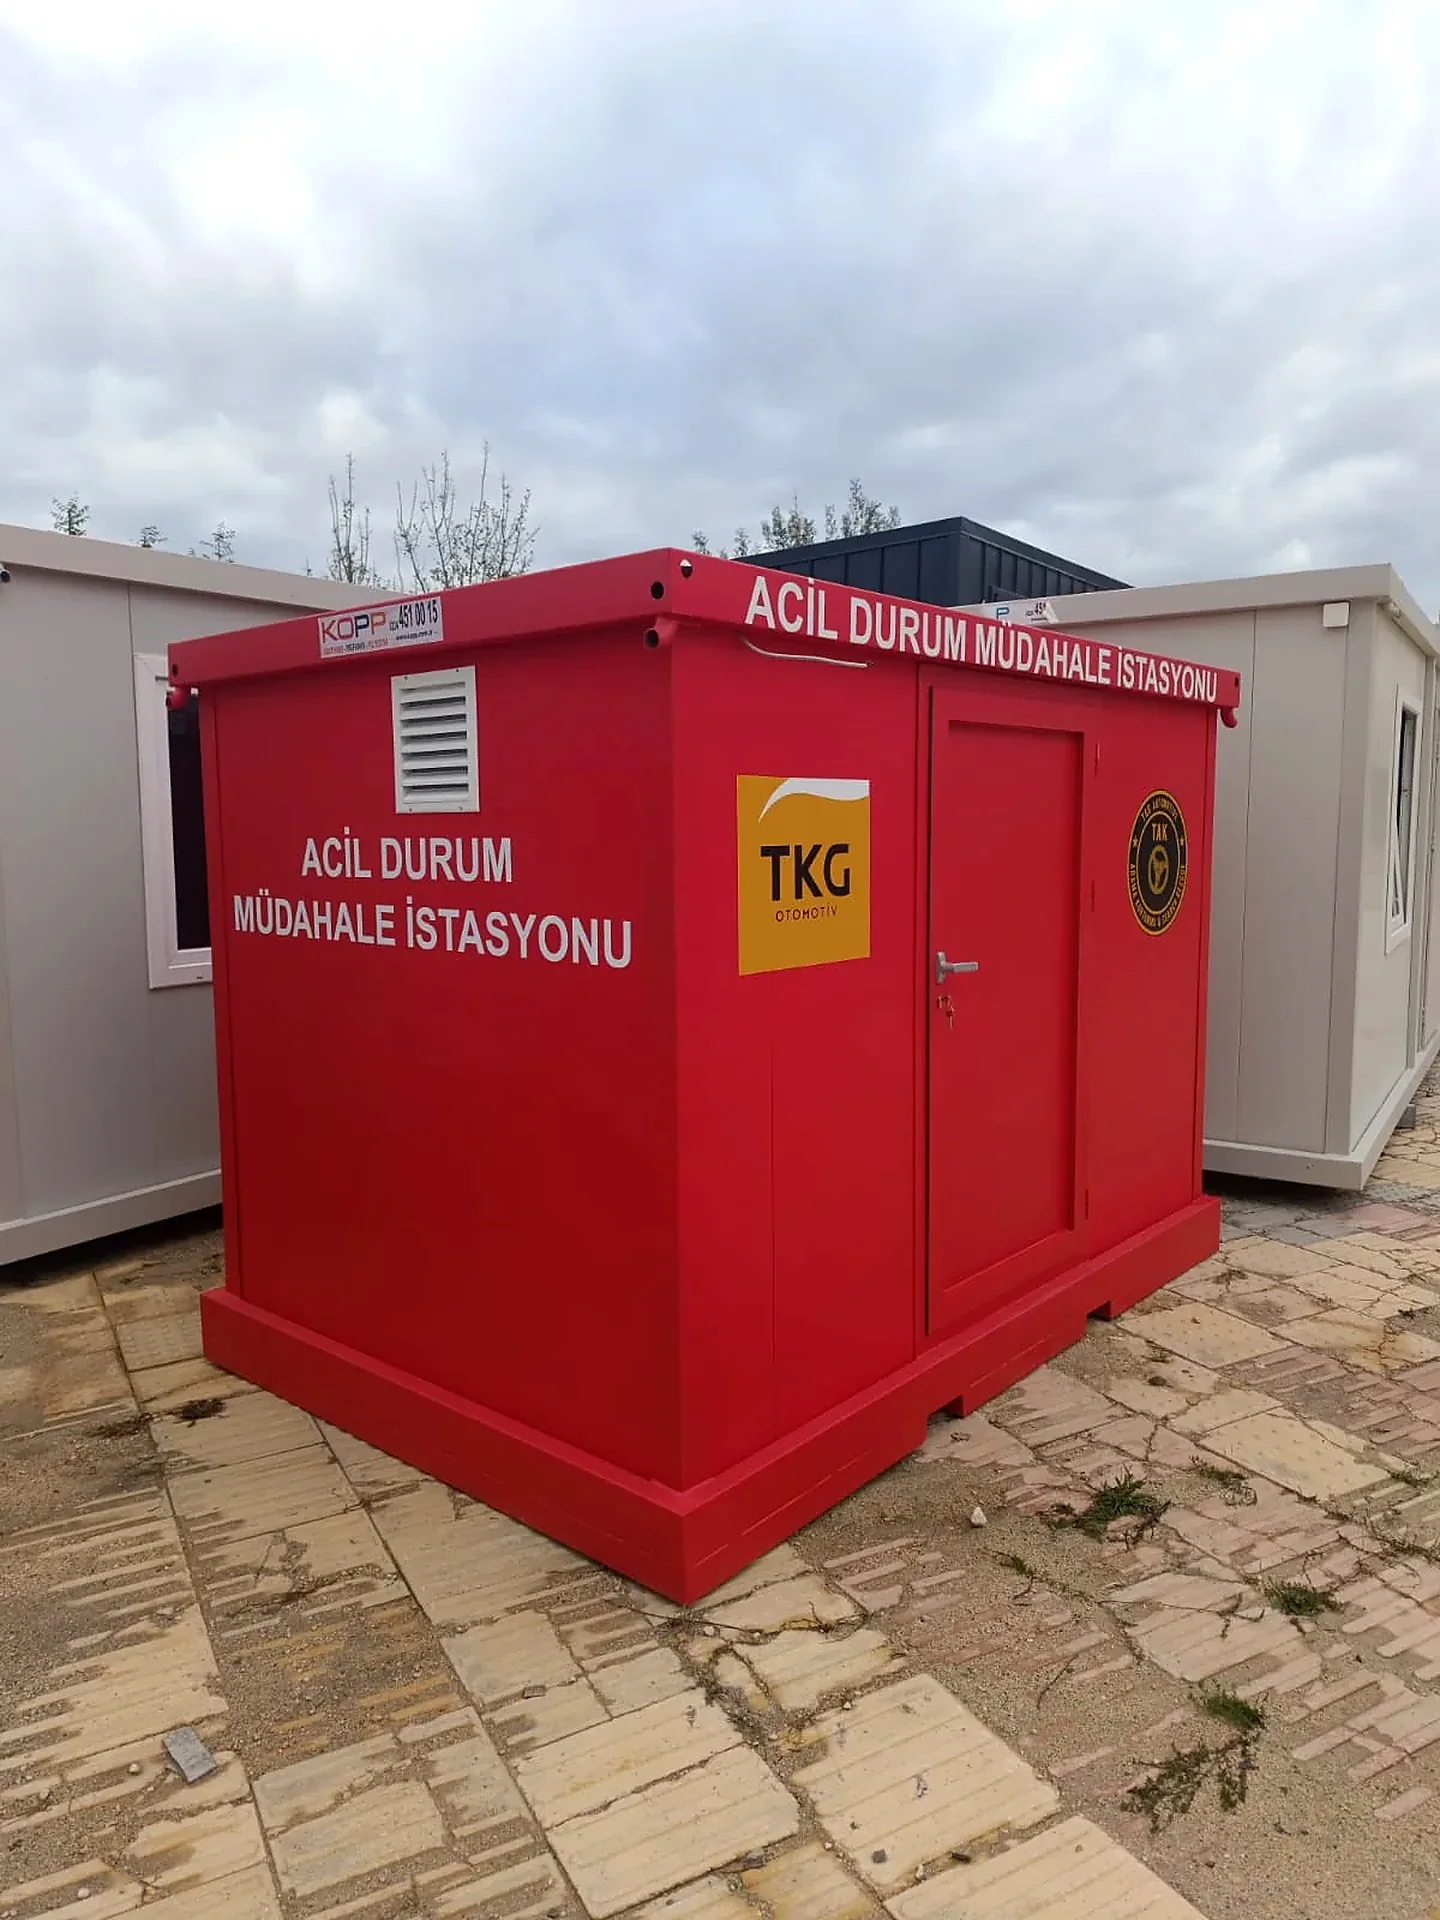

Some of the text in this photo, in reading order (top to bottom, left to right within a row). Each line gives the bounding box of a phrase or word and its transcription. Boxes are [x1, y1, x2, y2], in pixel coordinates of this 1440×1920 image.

[321, 611, 387, 644] KOPP
[745, 576, 1218, 703] ACİL DURUM MÜDAHALE İSTASYONU
[302, 826, 511, 882] ACİL DURUM
[1151, 823, 1168, 841] TAK
[760, 844, 850, 901] TKG
[234, 889, 632, 969] MÜDAHALE İSTASYONU
[775, 903, 837, 922] OTOMOTİV
